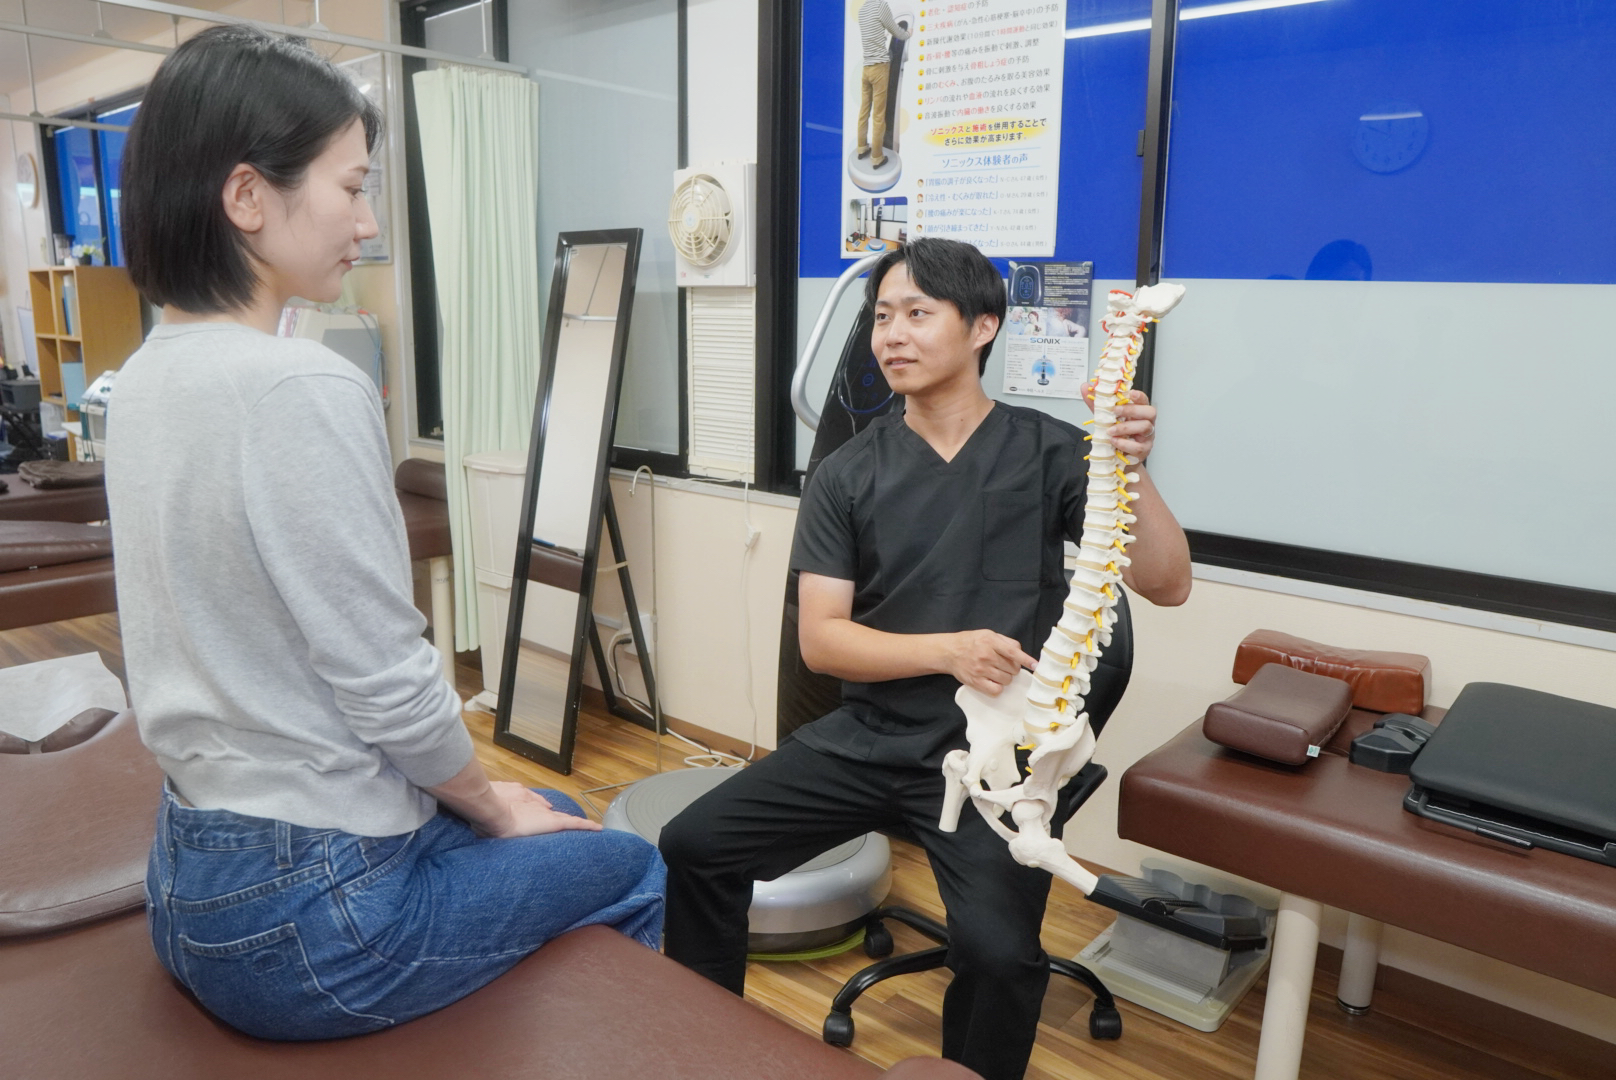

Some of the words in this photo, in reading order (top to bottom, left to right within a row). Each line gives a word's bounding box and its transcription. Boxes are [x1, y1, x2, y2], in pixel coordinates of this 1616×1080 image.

[930, 118, 1047, 136] ソニックスと施術を併用することで
[942, 153, 1028, 169] ソニックス体験者の声
[1030, 337, 1061, 345] SONIX
